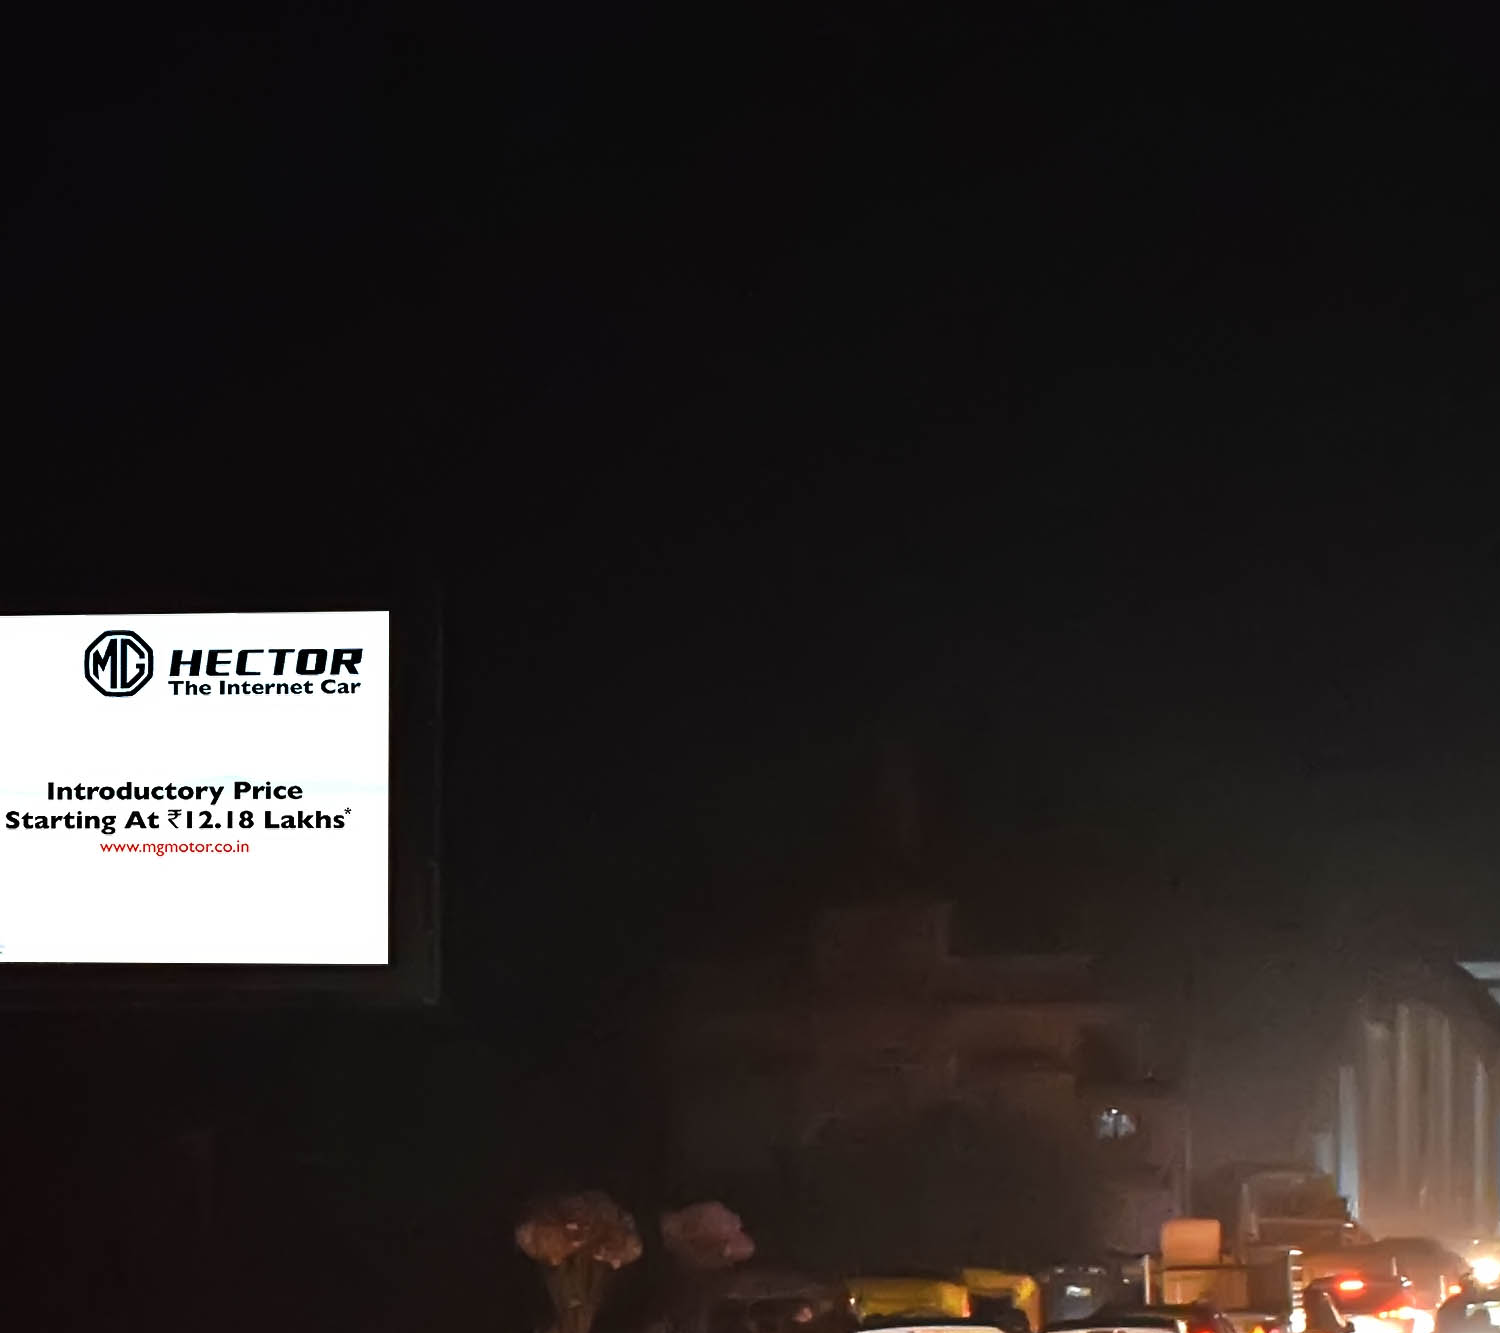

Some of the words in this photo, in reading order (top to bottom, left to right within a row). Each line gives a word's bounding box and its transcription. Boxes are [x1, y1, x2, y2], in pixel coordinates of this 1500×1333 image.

[89, 634, 150, 693] MG
[169, 648, 363, 676] HECTOR
[168, 680, 212, 695] The
[220, 679, 314, 695] Internet
[321, 679, 361, 694] Car
[48, 782, 225, 805] Introductory
[233, 781, 304, 800] Price
[5, 811, 117, 834] Starting
[125, 811, 160, 829] At
[100, 840, 250, 856] www.mgmotor.co.in
